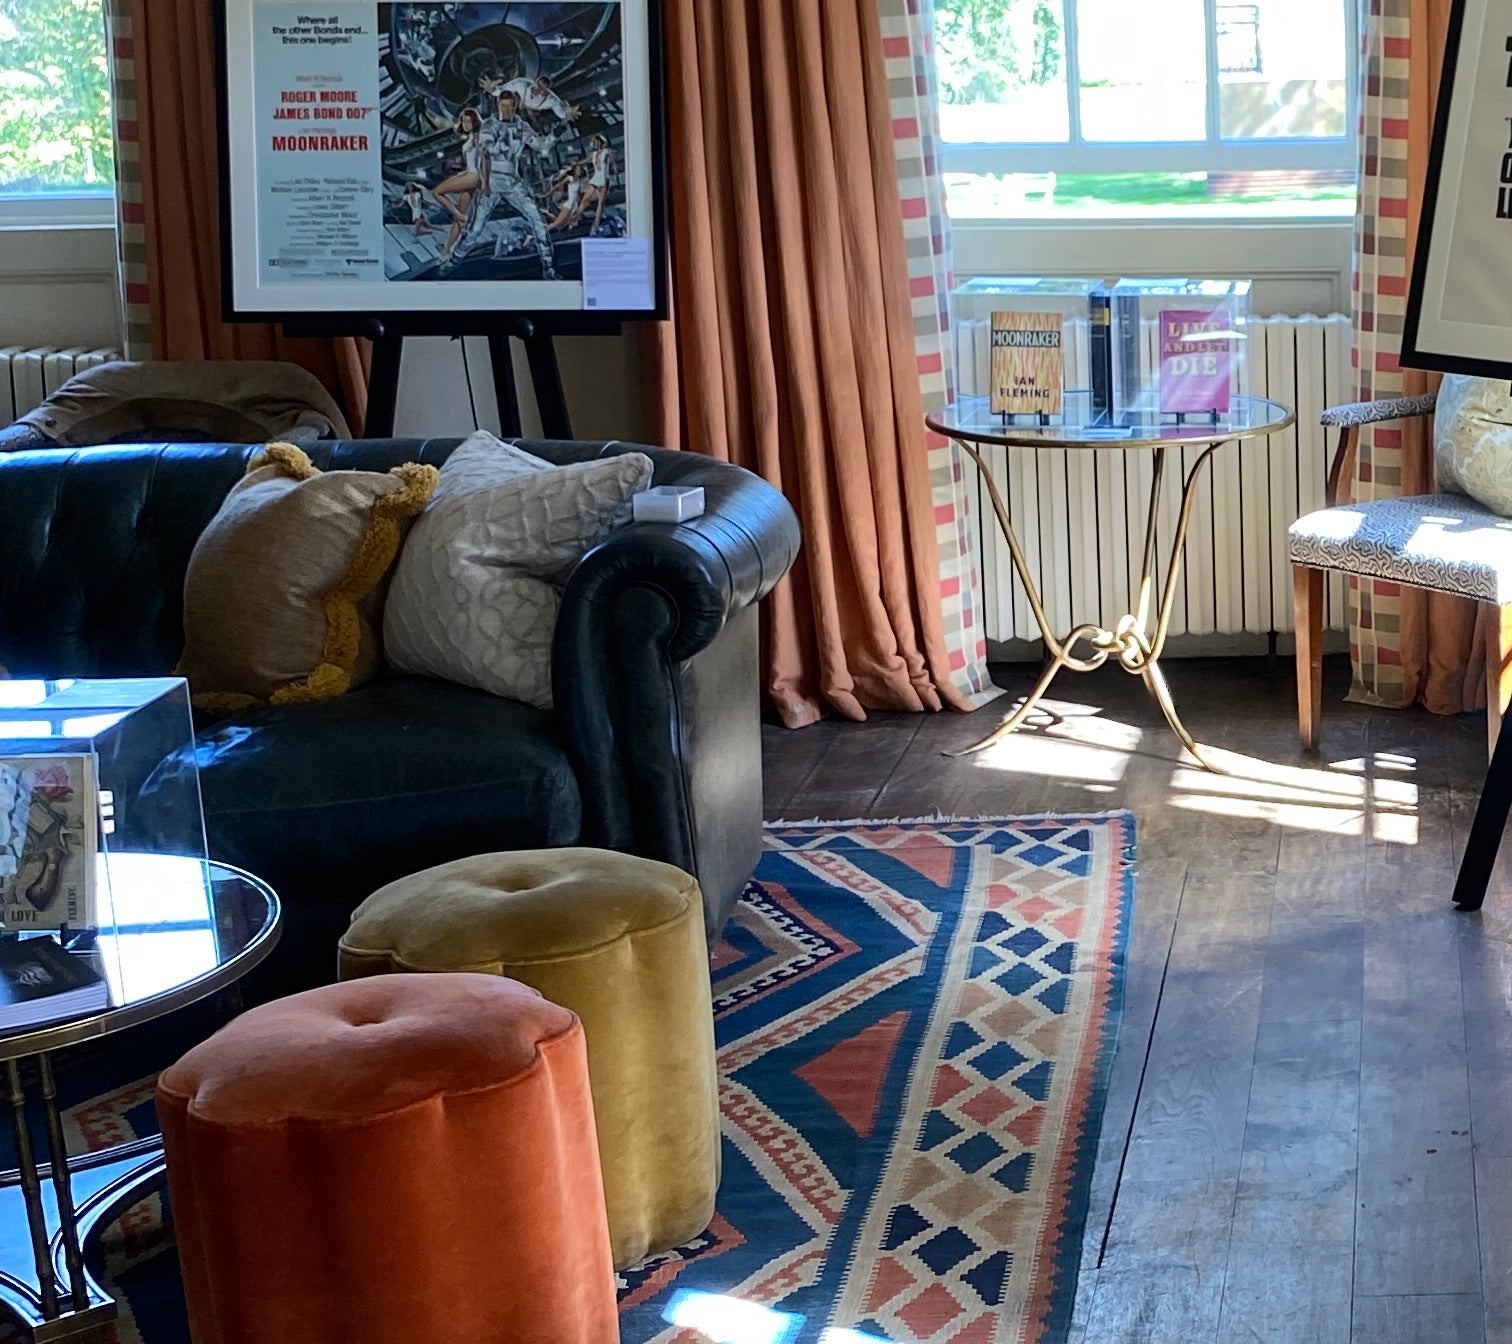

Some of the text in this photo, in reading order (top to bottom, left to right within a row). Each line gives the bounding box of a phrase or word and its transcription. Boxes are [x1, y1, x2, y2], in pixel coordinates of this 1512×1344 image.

[281, 91, 357, 103] ROGER MOORE
[272, 108, 310, 120] JAMES
[313, 108, 343, 120] BOND
[272, 136, 368, 151] MOONRAKER
[992, 330, 1060, 347] MOONRAKER
[1163, 342, 1196, 353] AND
[1170, 357, 1217, 376] DIE
[1014, 376, 1035, 386] IAN
[1000, 387, 1050, 399] FLEMING
